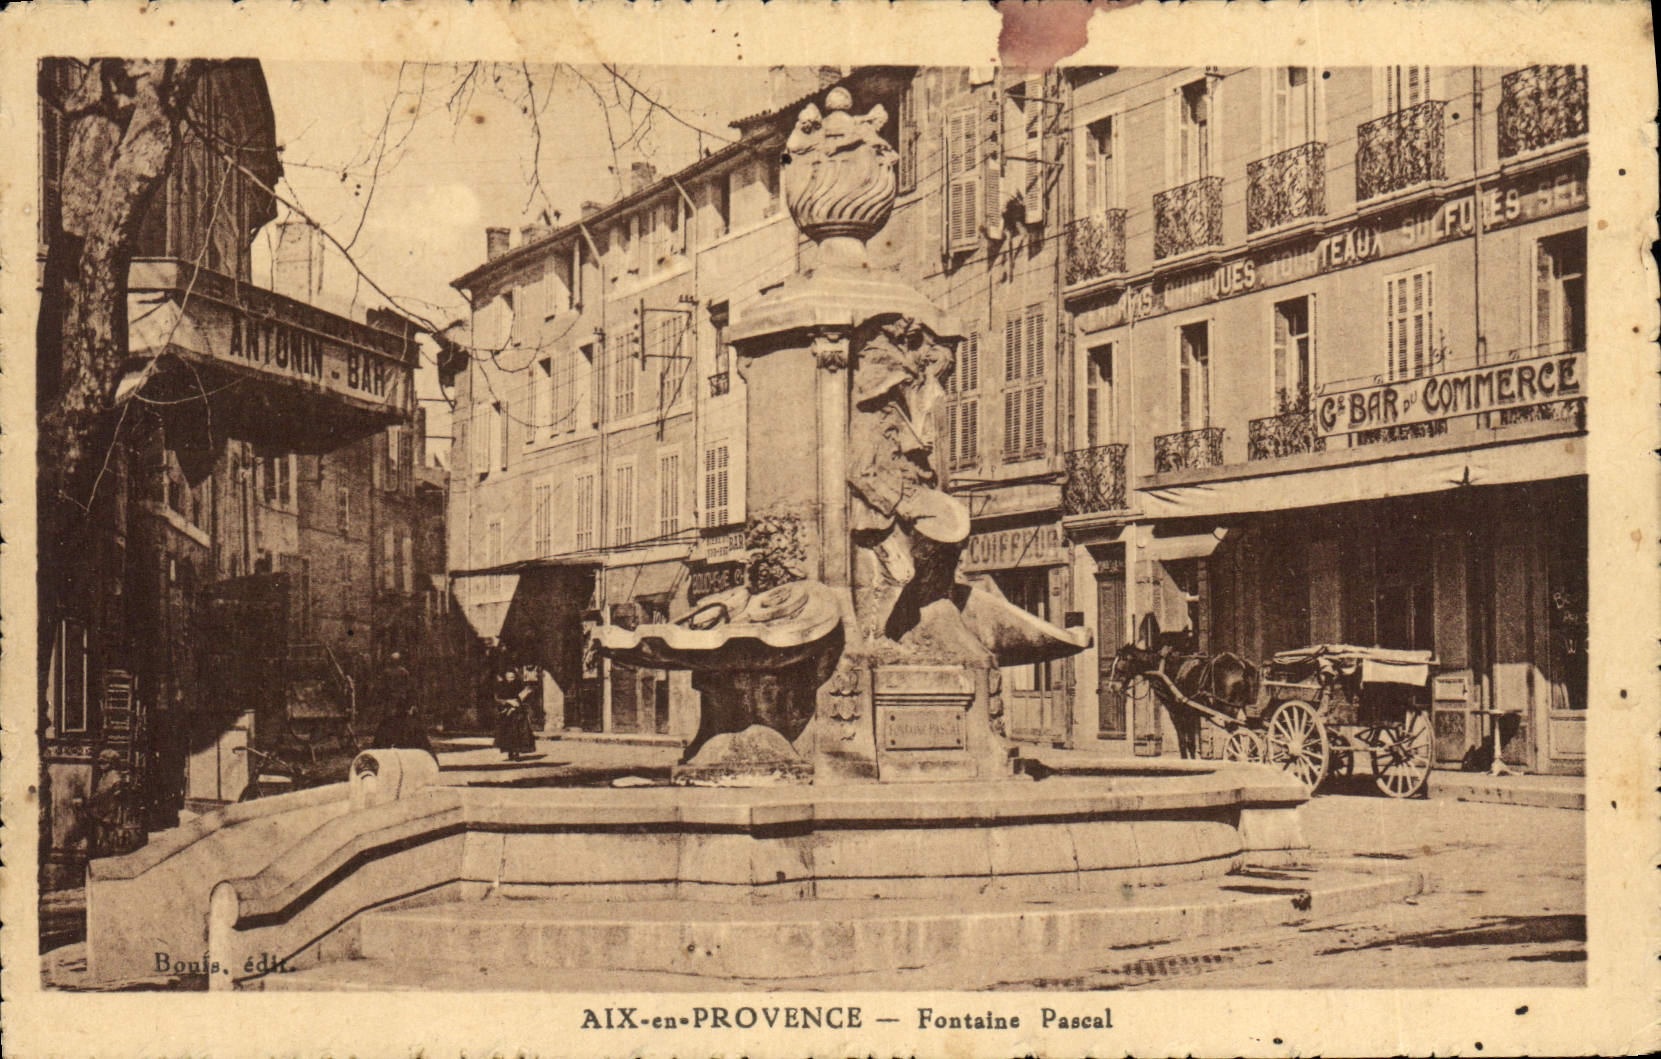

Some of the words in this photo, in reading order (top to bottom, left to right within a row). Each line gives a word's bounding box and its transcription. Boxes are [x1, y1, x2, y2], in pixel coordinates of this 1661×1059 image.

[230, 314, 323, 379] ANTONIN
[1349, 387, 1399, 427] BAR
[1423, 357, 1580, 415] COMMERCE
[969, 527, 1060, 564] COIFFEUR
